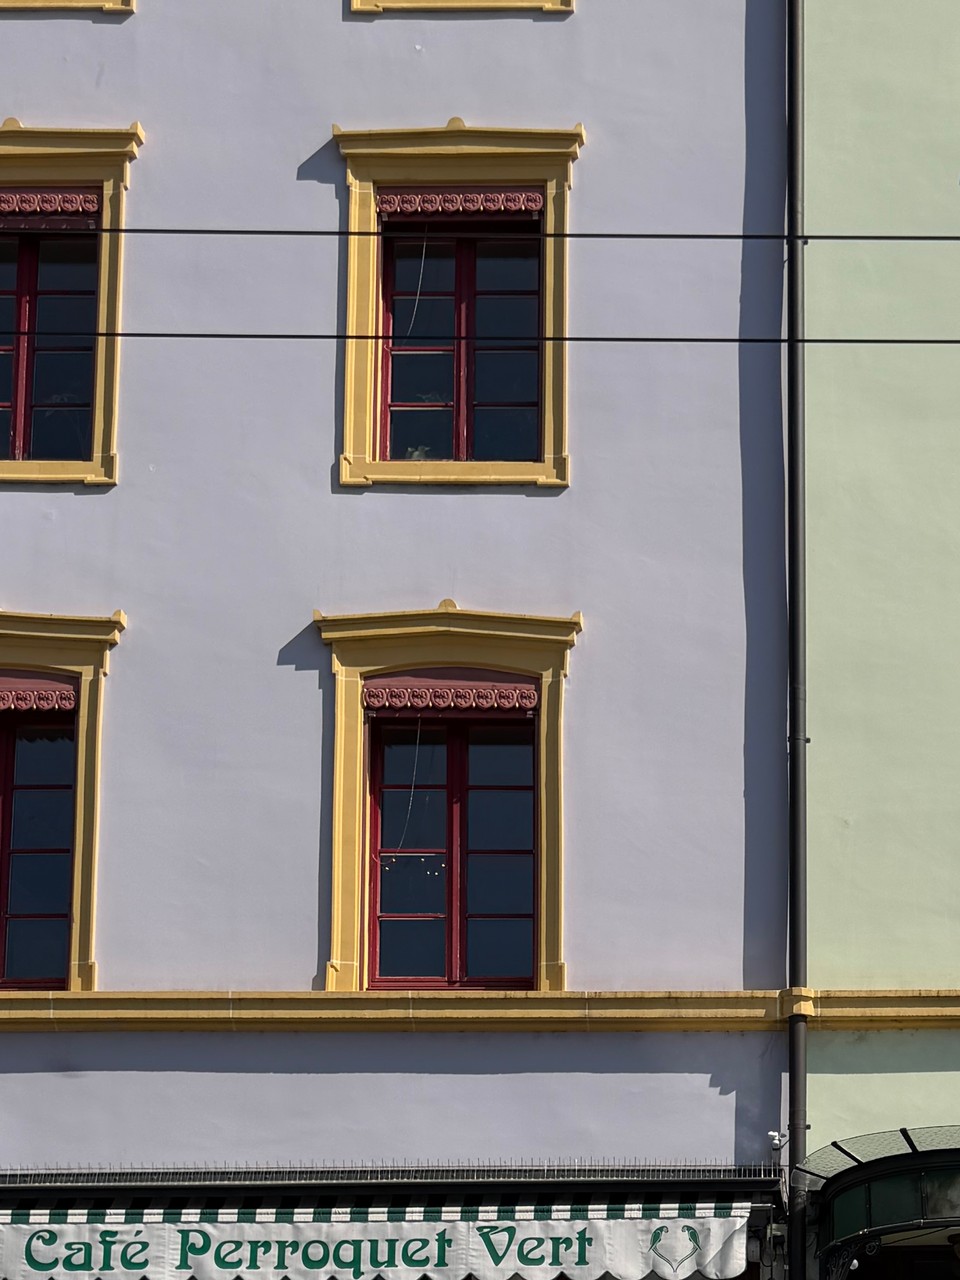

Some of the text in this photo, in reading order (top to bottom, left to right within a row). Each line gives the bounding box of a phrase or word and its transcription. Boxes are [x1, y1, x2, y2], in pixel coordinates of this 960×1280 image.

[25, 1226, 592, 1280] Café Perroquet Vert
